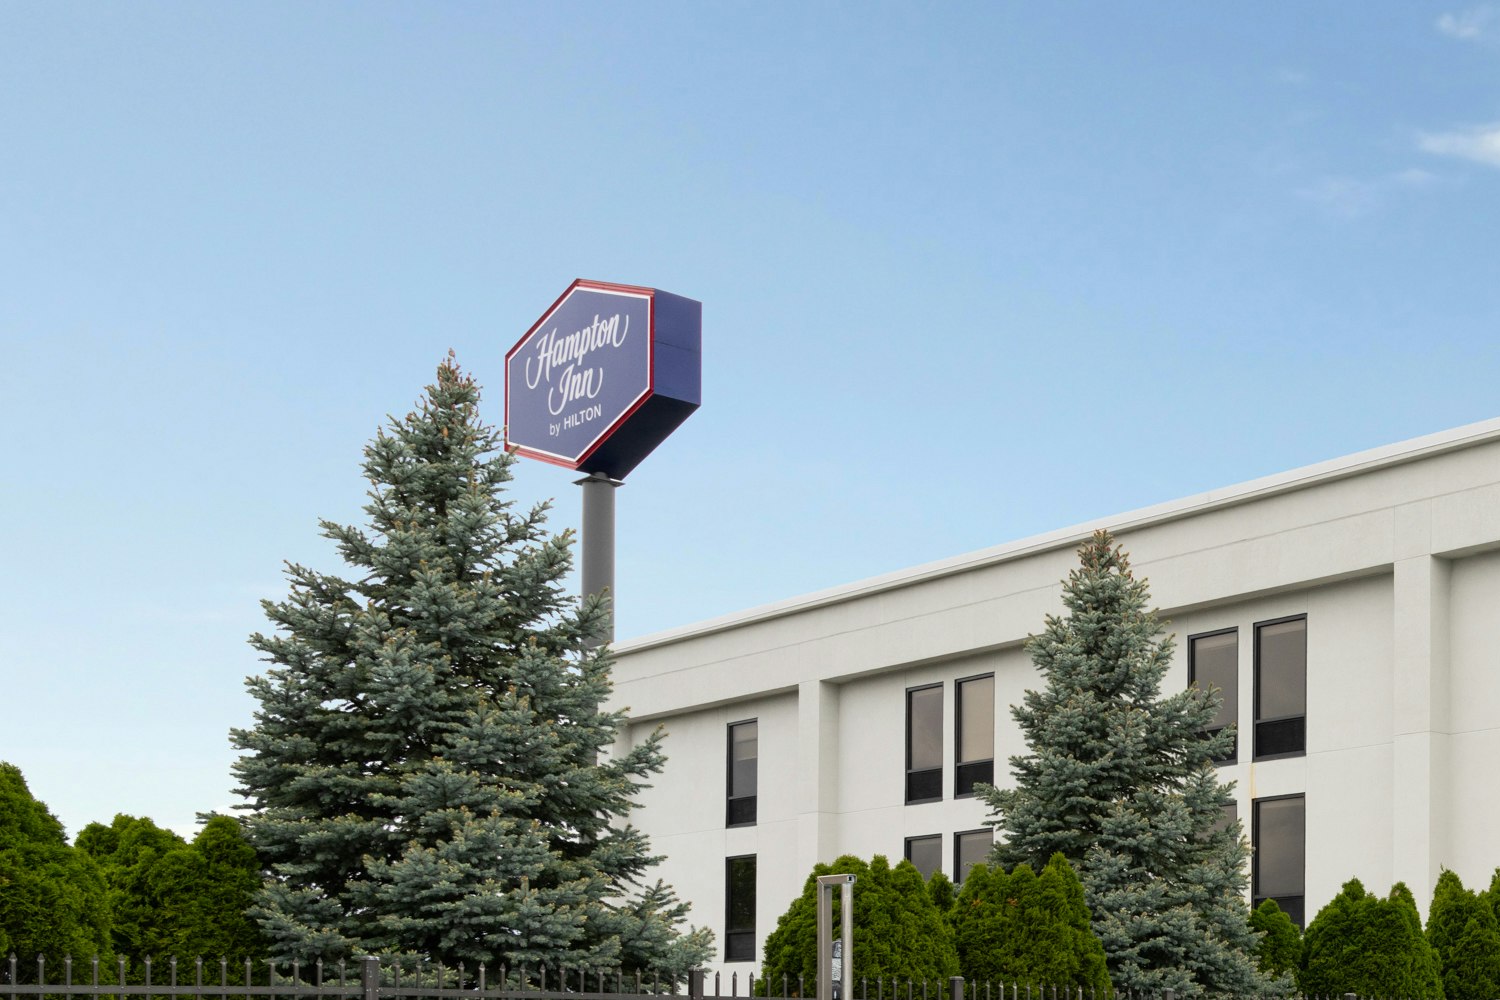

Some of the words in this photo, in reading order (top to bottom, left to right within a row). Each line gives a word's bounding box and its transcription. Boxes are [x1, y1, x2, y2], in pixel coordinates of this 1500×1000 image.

[525, 314, 629, 389] Hampton
[548, 364, 603, 415] Inn
[549, 423, 561, 437] by
[563, 404, 602, 430] HILTON
